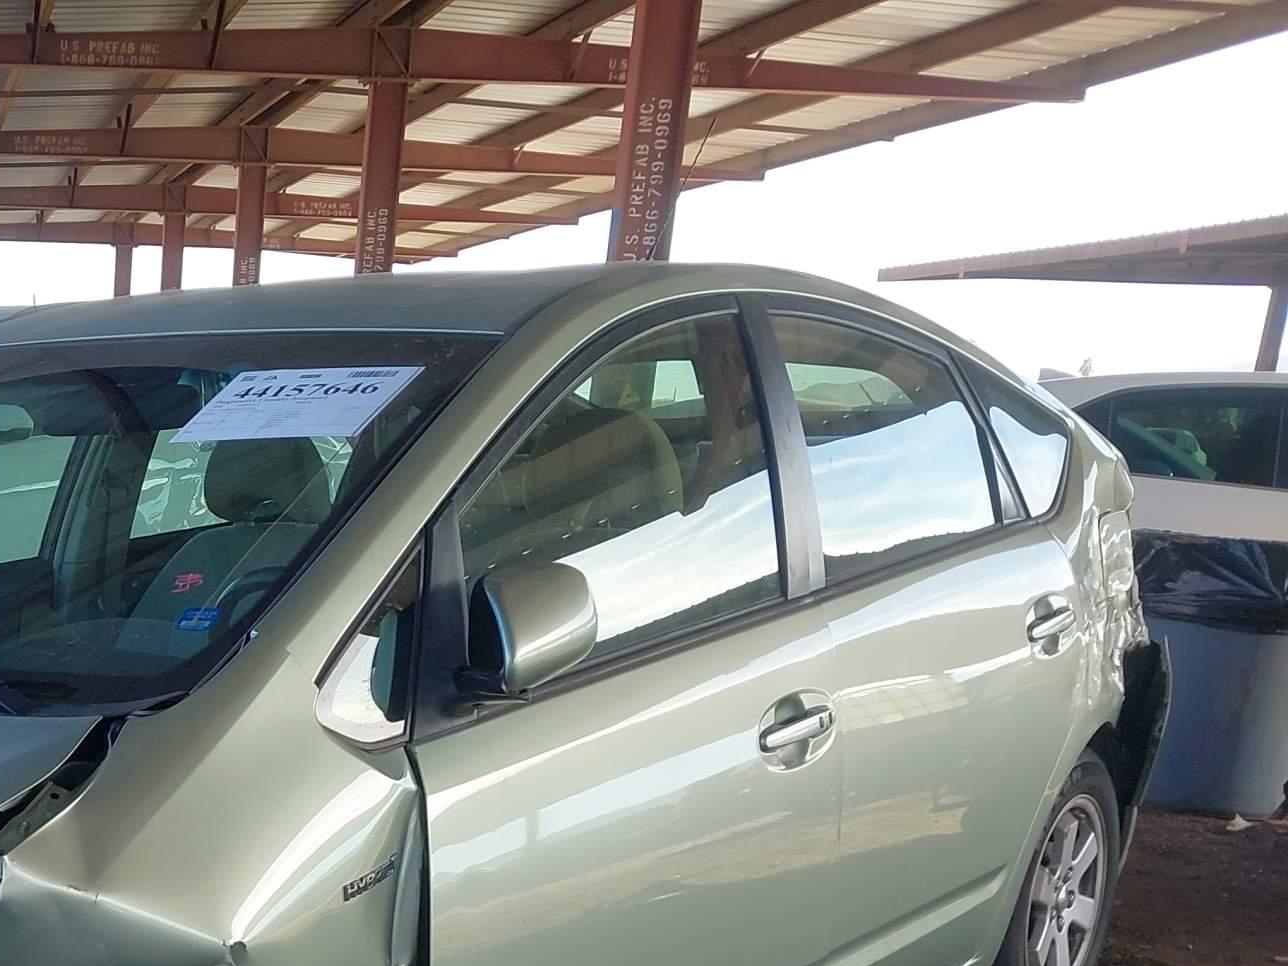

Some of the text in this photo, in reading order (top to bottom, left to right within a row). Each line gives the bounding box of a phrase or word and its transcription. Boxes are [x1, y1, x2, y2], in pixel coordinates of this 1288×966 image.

[88, 41, 136, 55] PREFAB
[637, 96, 656, 133] INC.
[628, 143, 650, 217] PREFAB
[234, 381, 384, 399] 44157646
